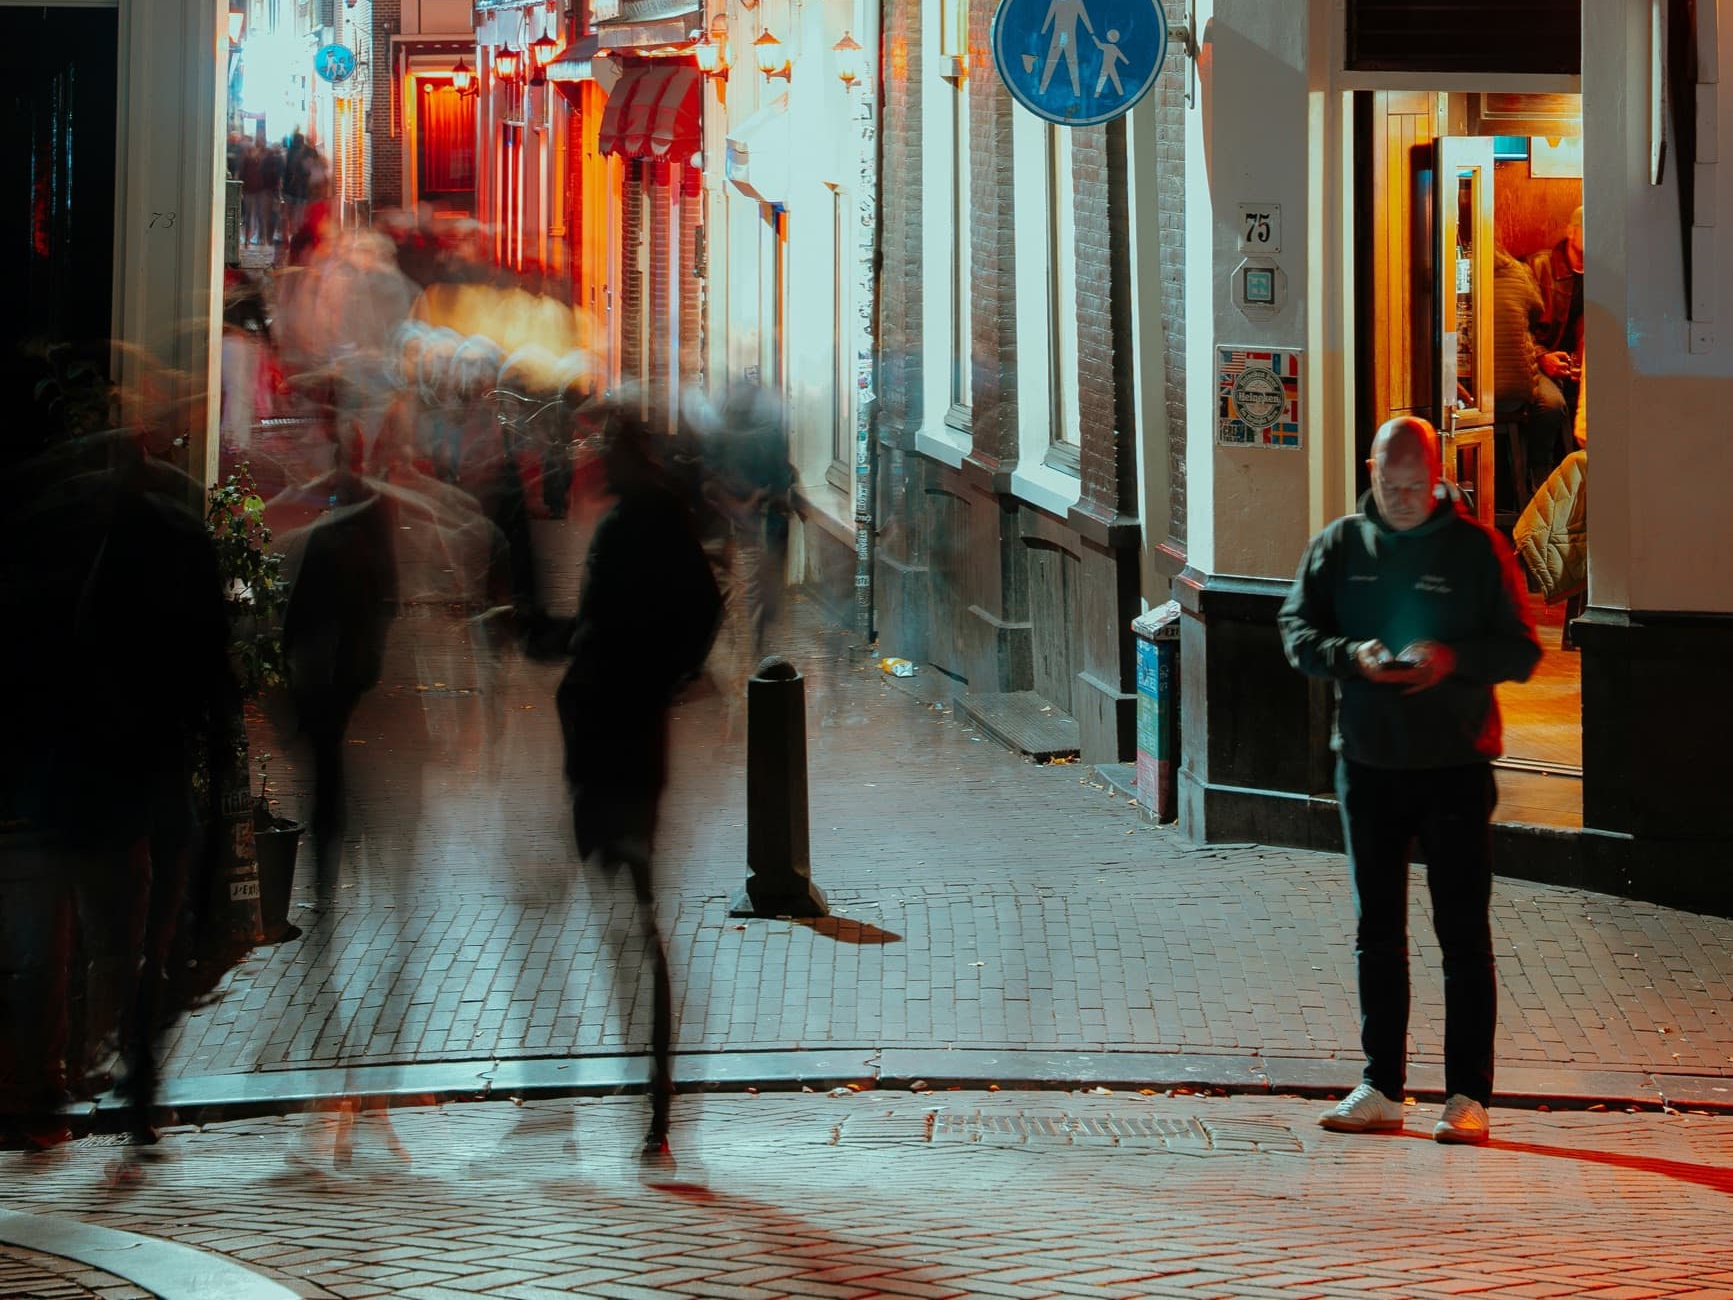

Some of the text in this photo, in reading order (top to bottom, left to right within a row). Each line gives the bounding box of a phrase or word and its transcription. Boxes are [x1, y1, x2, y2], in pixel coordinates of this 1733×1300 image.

[148, 211, 177, 229] 73
[1245, 213, 1271, 243] 75
[1238, 390, 1281, 404] Heineken
